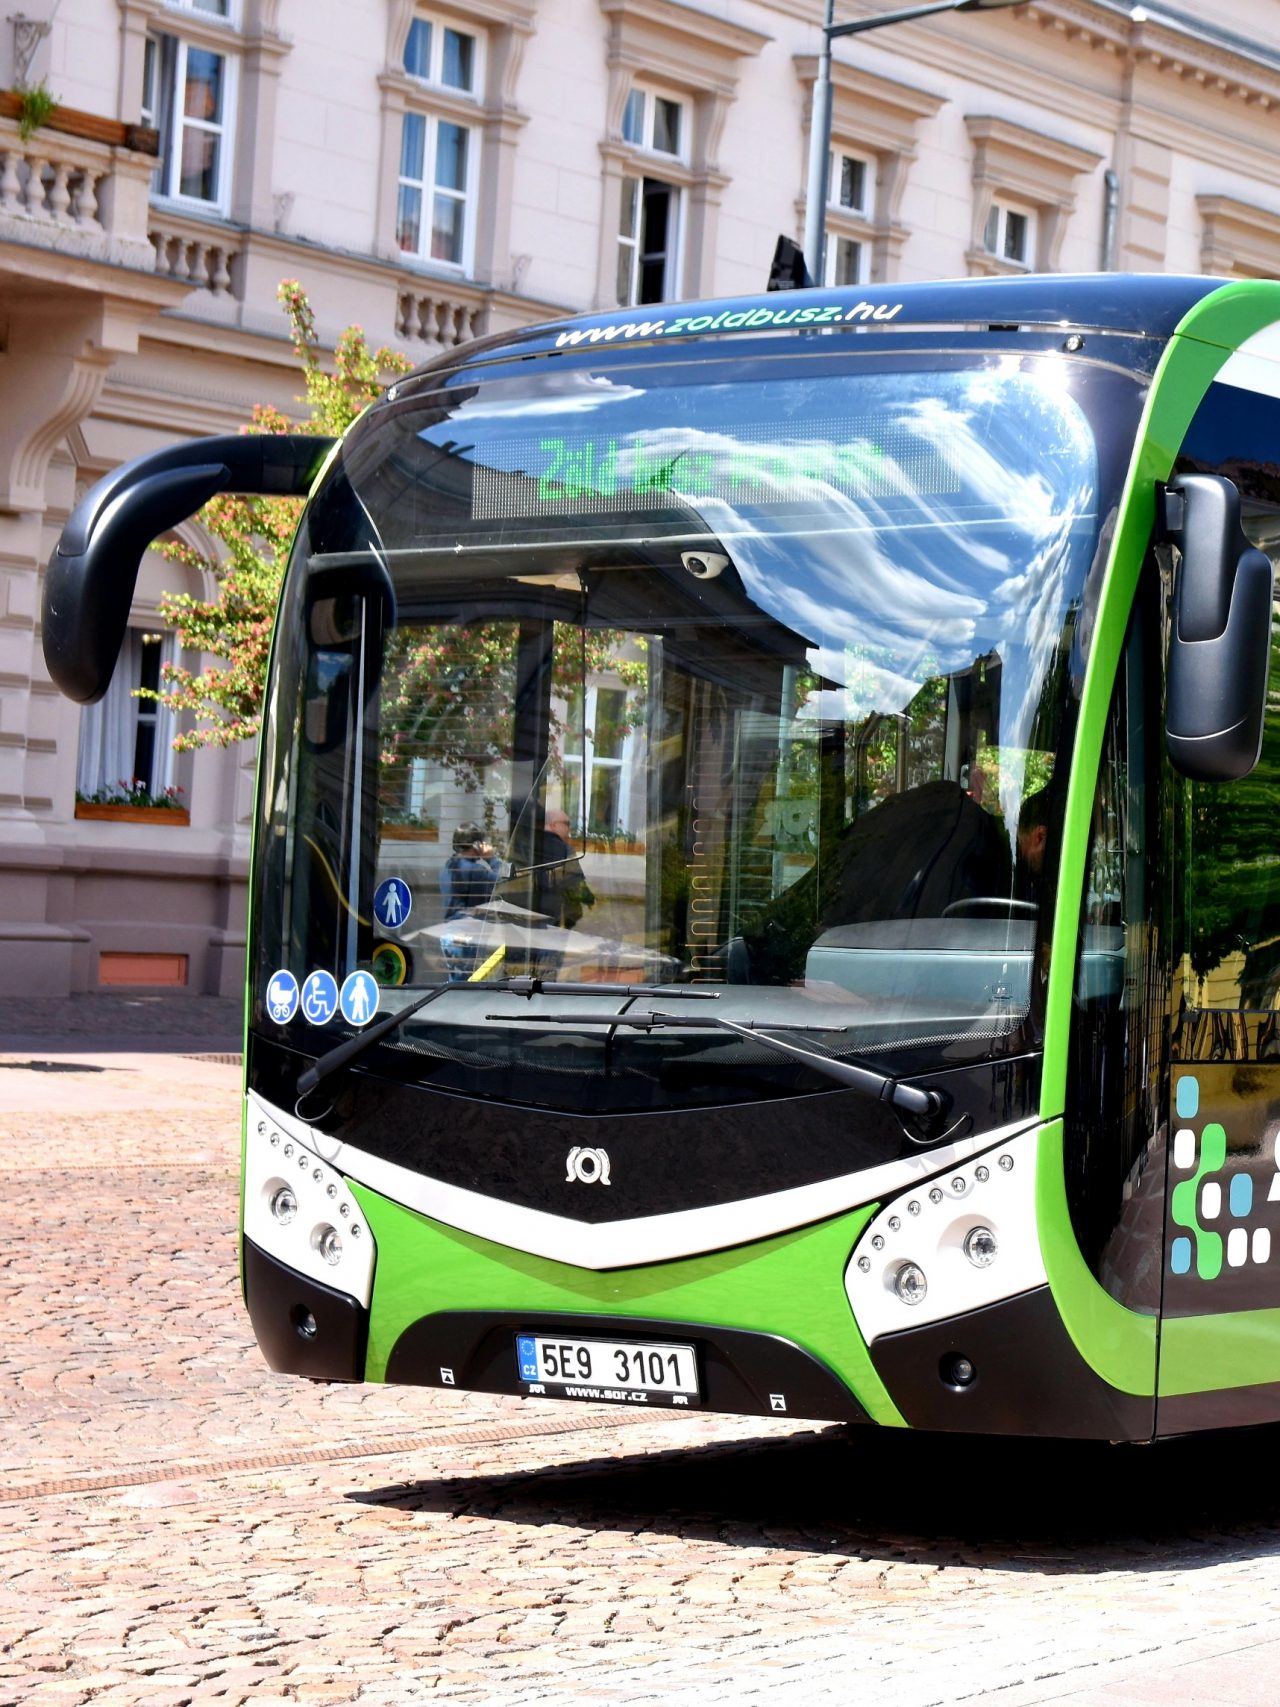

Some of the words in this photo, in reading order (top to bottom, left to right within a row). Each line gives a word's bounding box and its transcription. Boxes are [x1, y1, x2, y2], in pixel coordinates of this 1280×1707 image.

[555, 301, 903, 347] www.zoldbusz.hu
[523, 1364, 537, 1376] CZ
[542, 1343, 593, 1380] 5E9
[613, 1349, 682, 1387] 3101
[565, 1386, 648, 1402] www.sor.cz
